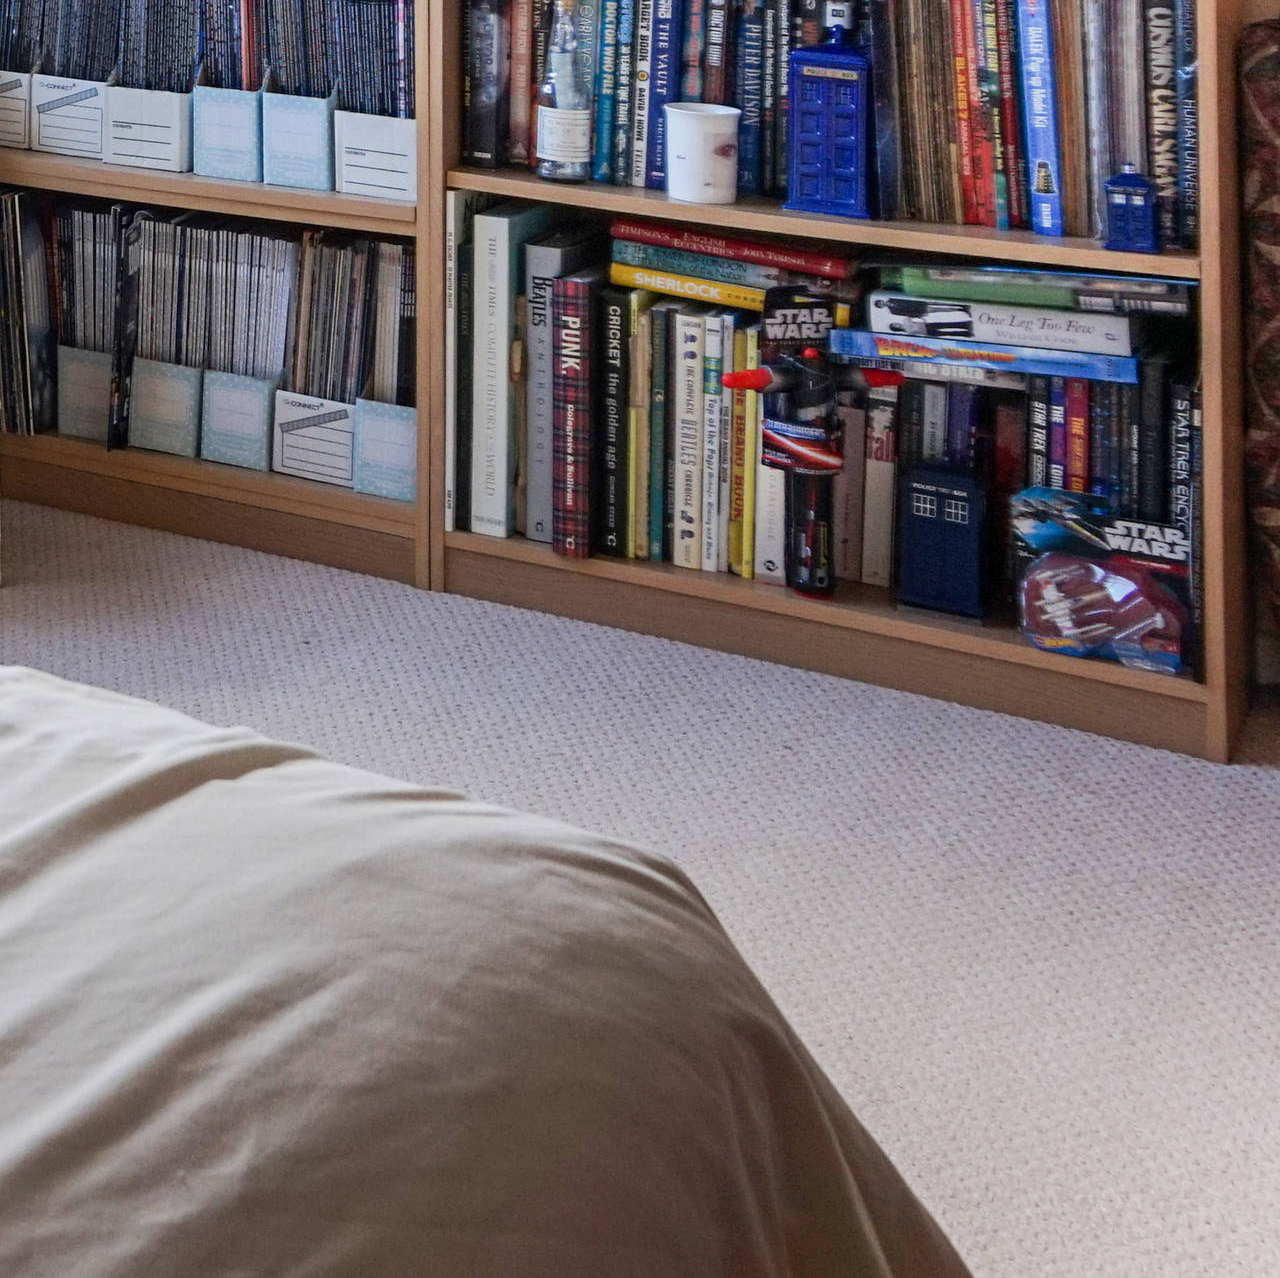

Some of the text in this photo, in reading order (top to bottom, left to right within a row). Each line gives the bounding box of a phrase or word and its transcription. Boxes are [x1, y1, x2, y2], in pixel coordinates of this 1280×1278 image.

[581, 5, 595, 47] EARLY
[605, 2, 616, 44] DOCTOR
[984, 13, 995, 27] THE
[997, 0, 1008, 33] EMPIRE
[537, 33, 545, 54] PETER
[638, 34, 650, 62] BOOK
[708, 9, 724, 66] DOCTOR WHO
[986, 28, 997, 50] INSIDE
[1000, 35, 1011, 72] STRIKES
[1184, 29, 1193, 52] COX
[604, 46, 615, 72] WHO
[656, 23, 670, 95] THE VAULT
[743, 23, 761, 127] PETER DAVISON
[988, 51, 999, 72] STORY
[602, 74, 614, 95] FILE
[1003, 74, 1012, 99] BACK
[1028, 27, 1048, 128] DALEK Pop-up Model Kit
[637, 87, 646, 111] DAVID
[636, 119, 645, 142] HOWE
[960, 121, 969, 156] ANNUAL
[1183, 99, 1196, 147] HUMAN
[1151, 89, 1178, 197] CARL SAGAN
[1184, 150, 1196, 210] UNIVERSE
[672, 240, 735, 257] ECCENTRICS
[529, 276, 551, 327] BEATLES
[633, 272, 721, 299] SHERLOCK
[766, 308, 833, 324] STAR
[766, 324, 832, 339] WARS
[978, 312, 1096, 335] One Leg Too Few
[485, 285, 497, 497] TIMES HISTORY WORLD
[606, 305, 621, 469] CRICKET the golden age
[561, 315, 581, 506] PUNK. Colegrave Sullivan
[1033, 402, 1046, 451] STAR TREK
[1051, 406, 1064, 423] THE
[1071, 417, 1084, 434] THE
[679, 419, 697, 466] BEATLES
[706, 398, 718, 470] Top of the Pops
[734, 415, 745, 467] BEANO
[1176, 400, 1189, 479] STAR TREK
[1103, 520, 1190, 546] STAR
[1105, 534, 1191, 560] WARS
